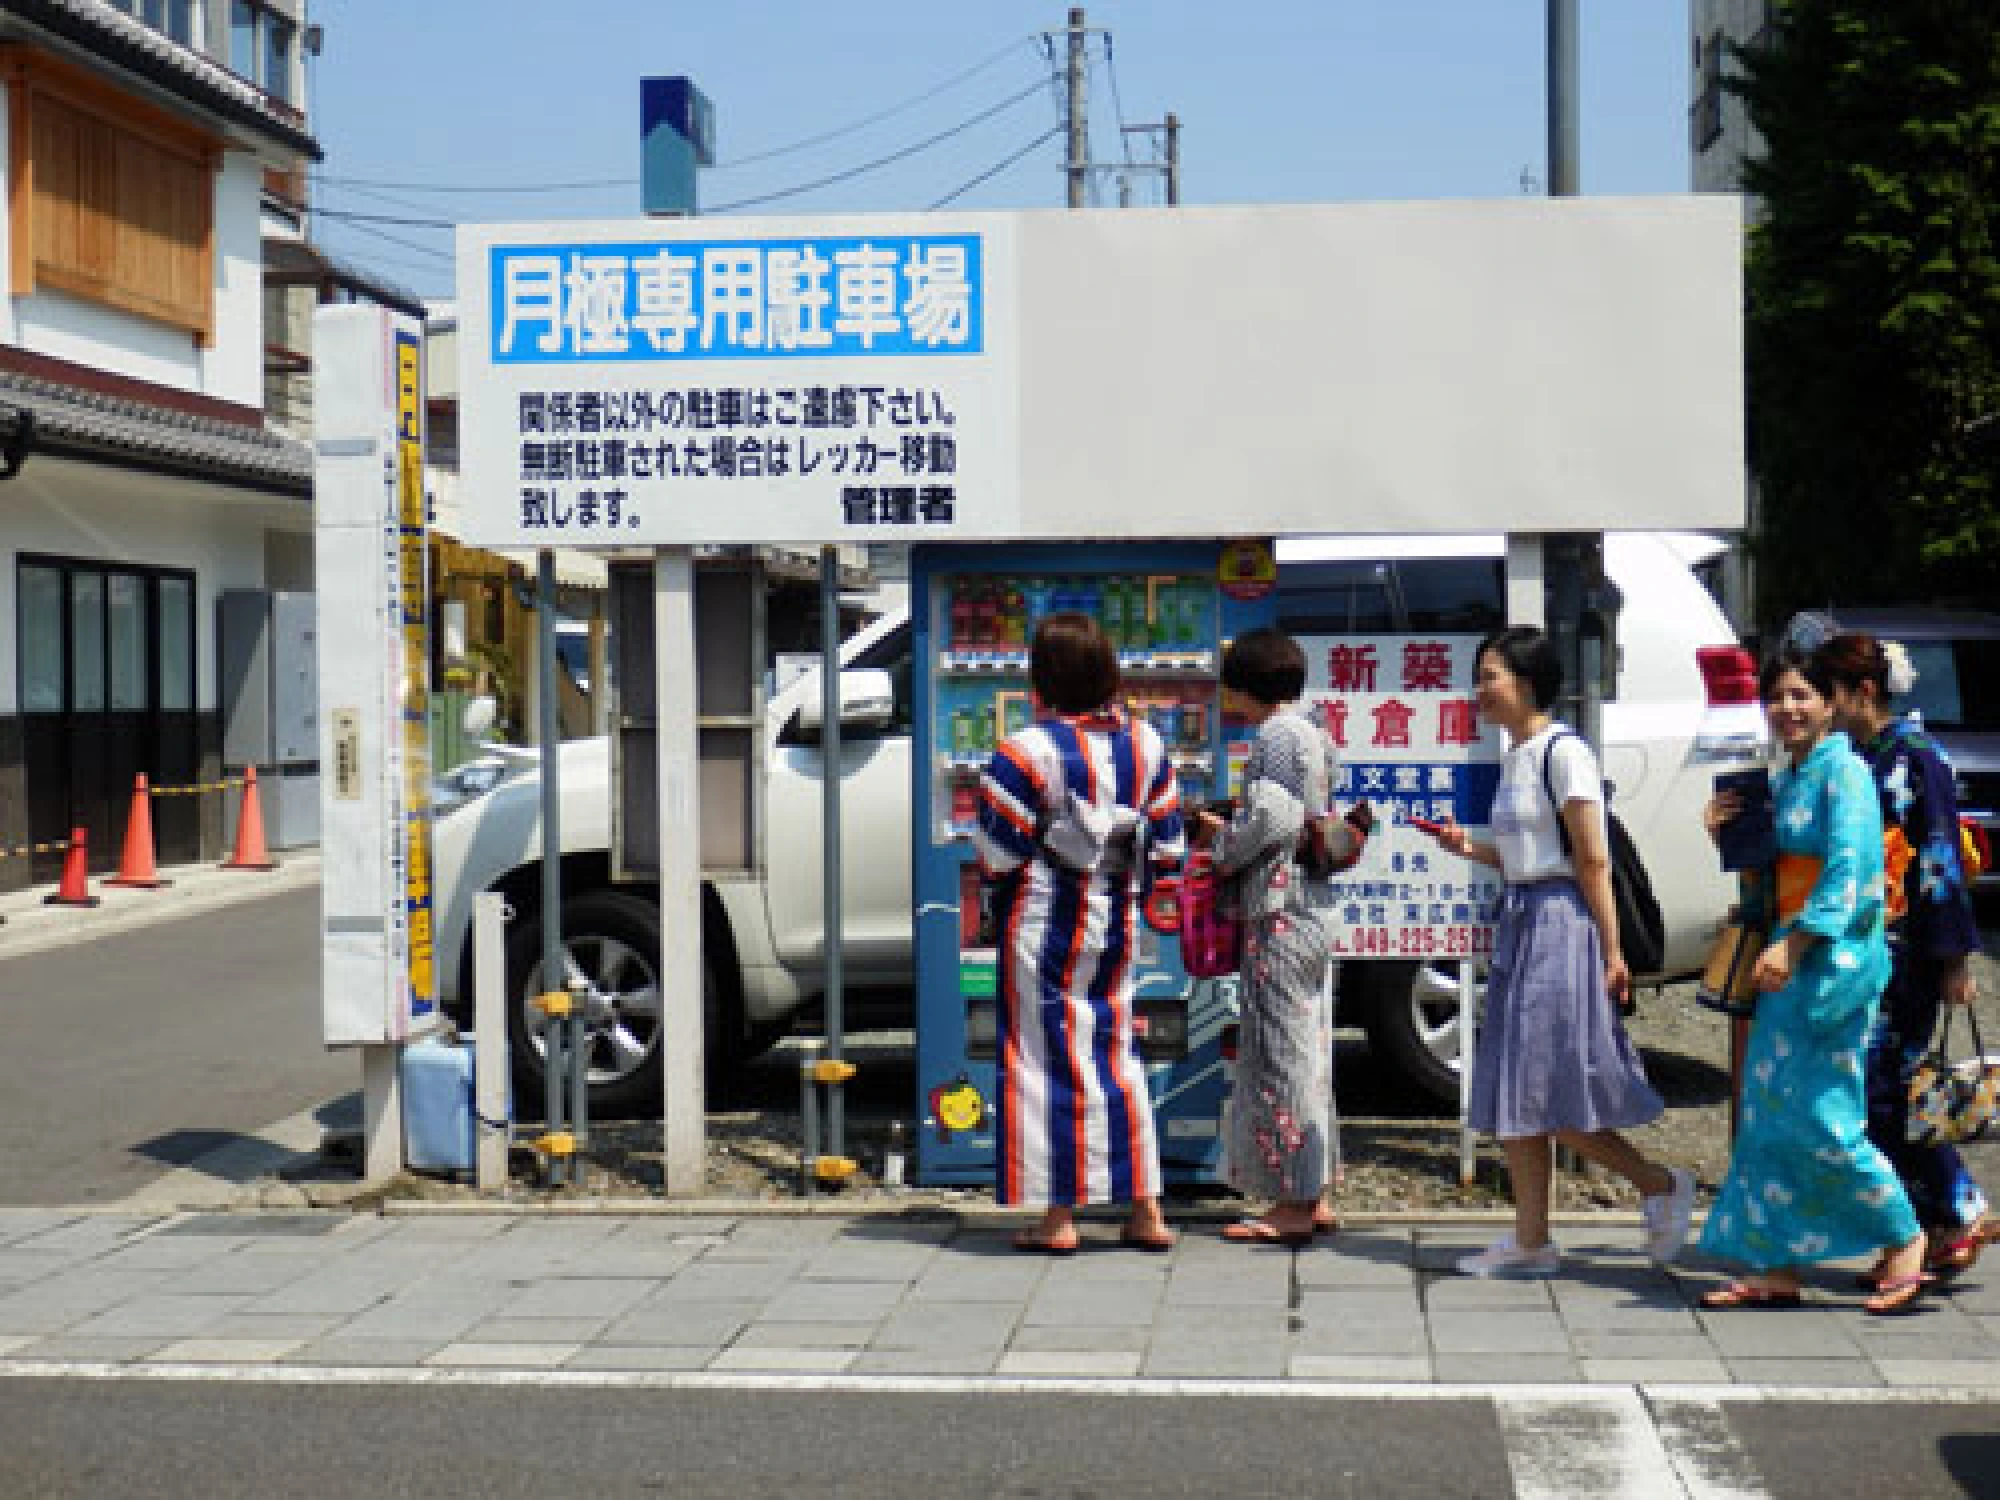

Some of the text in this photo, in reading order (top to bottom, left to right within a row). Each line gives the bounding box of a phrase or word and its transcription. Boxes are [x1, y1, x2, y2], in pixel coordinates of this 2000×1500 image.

[499, 244, 972, 354] 月極専用駐車場
[518, 386, 957, 433] 関係者以外の駐車はご遠慮下さい。
[519, 434, 957, 480] 無断駐車された場合はレッカー移動
[519, 486, 956, 529] 致します。 管理者
[1327, 642, 1453, 692] 新築
